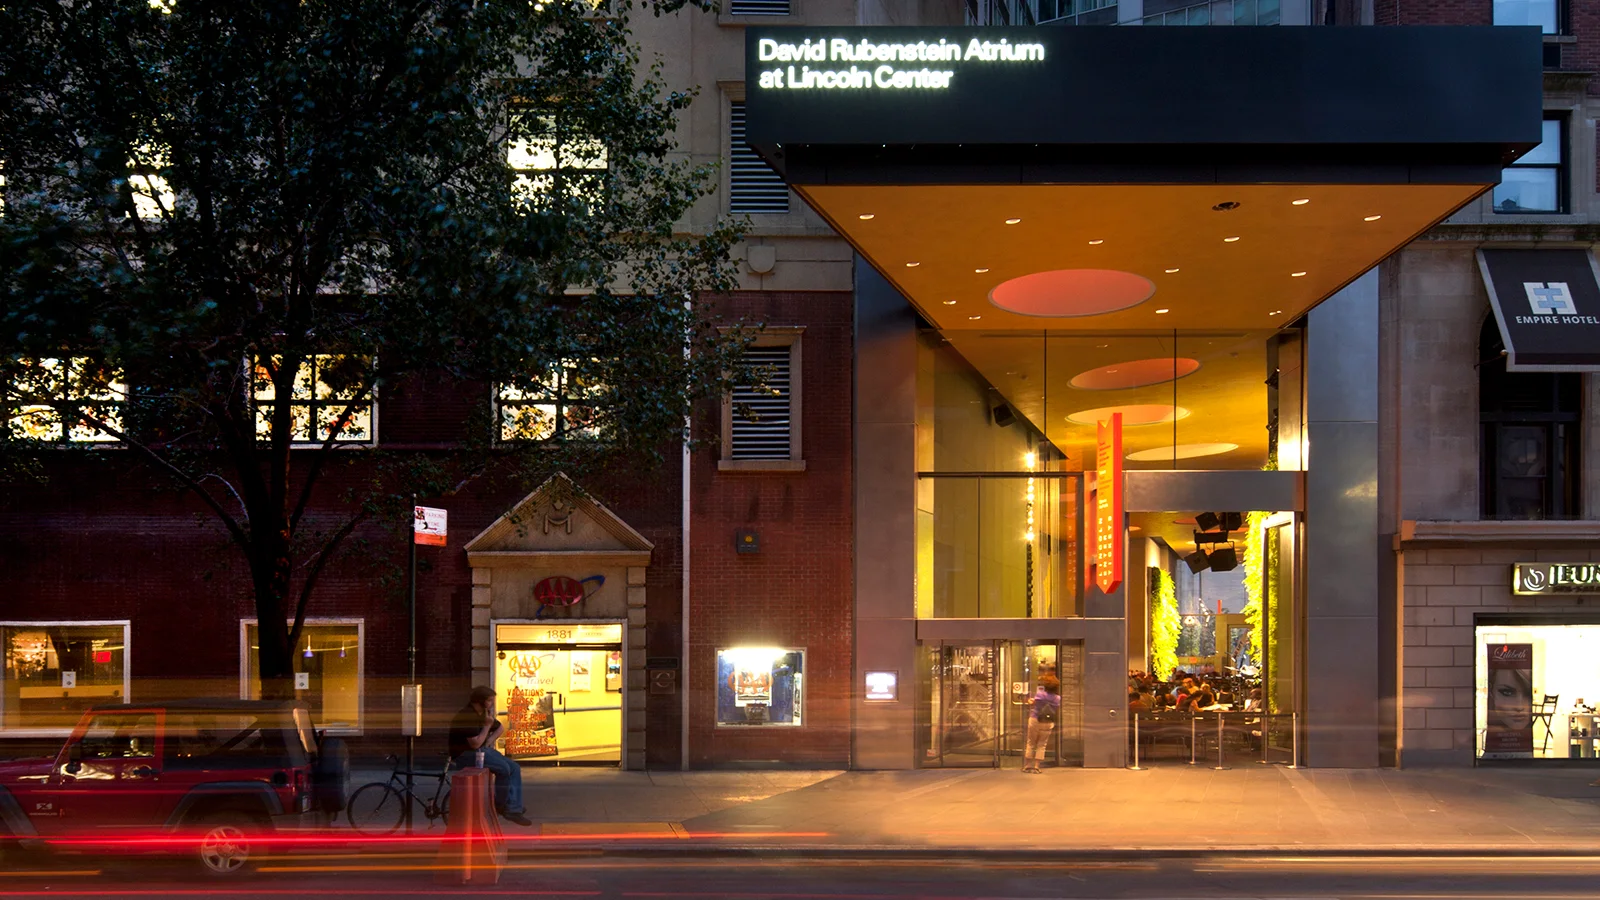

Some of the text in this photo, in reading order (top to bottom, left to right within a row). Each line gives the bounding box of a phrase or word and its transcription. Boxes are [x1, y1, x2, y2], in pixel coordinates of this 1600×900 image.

[758, 38, 1045, 61] David Rubenstein Atrium
[759, 65, 954, 89] at Lincoln Center
[1515, 316, 1600, 324] EMPIRE HOTEL
[536, 576, 583, 607] AAA
[547, 629, 572, 639] 1881
[507, 688, 545, 697] VACATIONS
